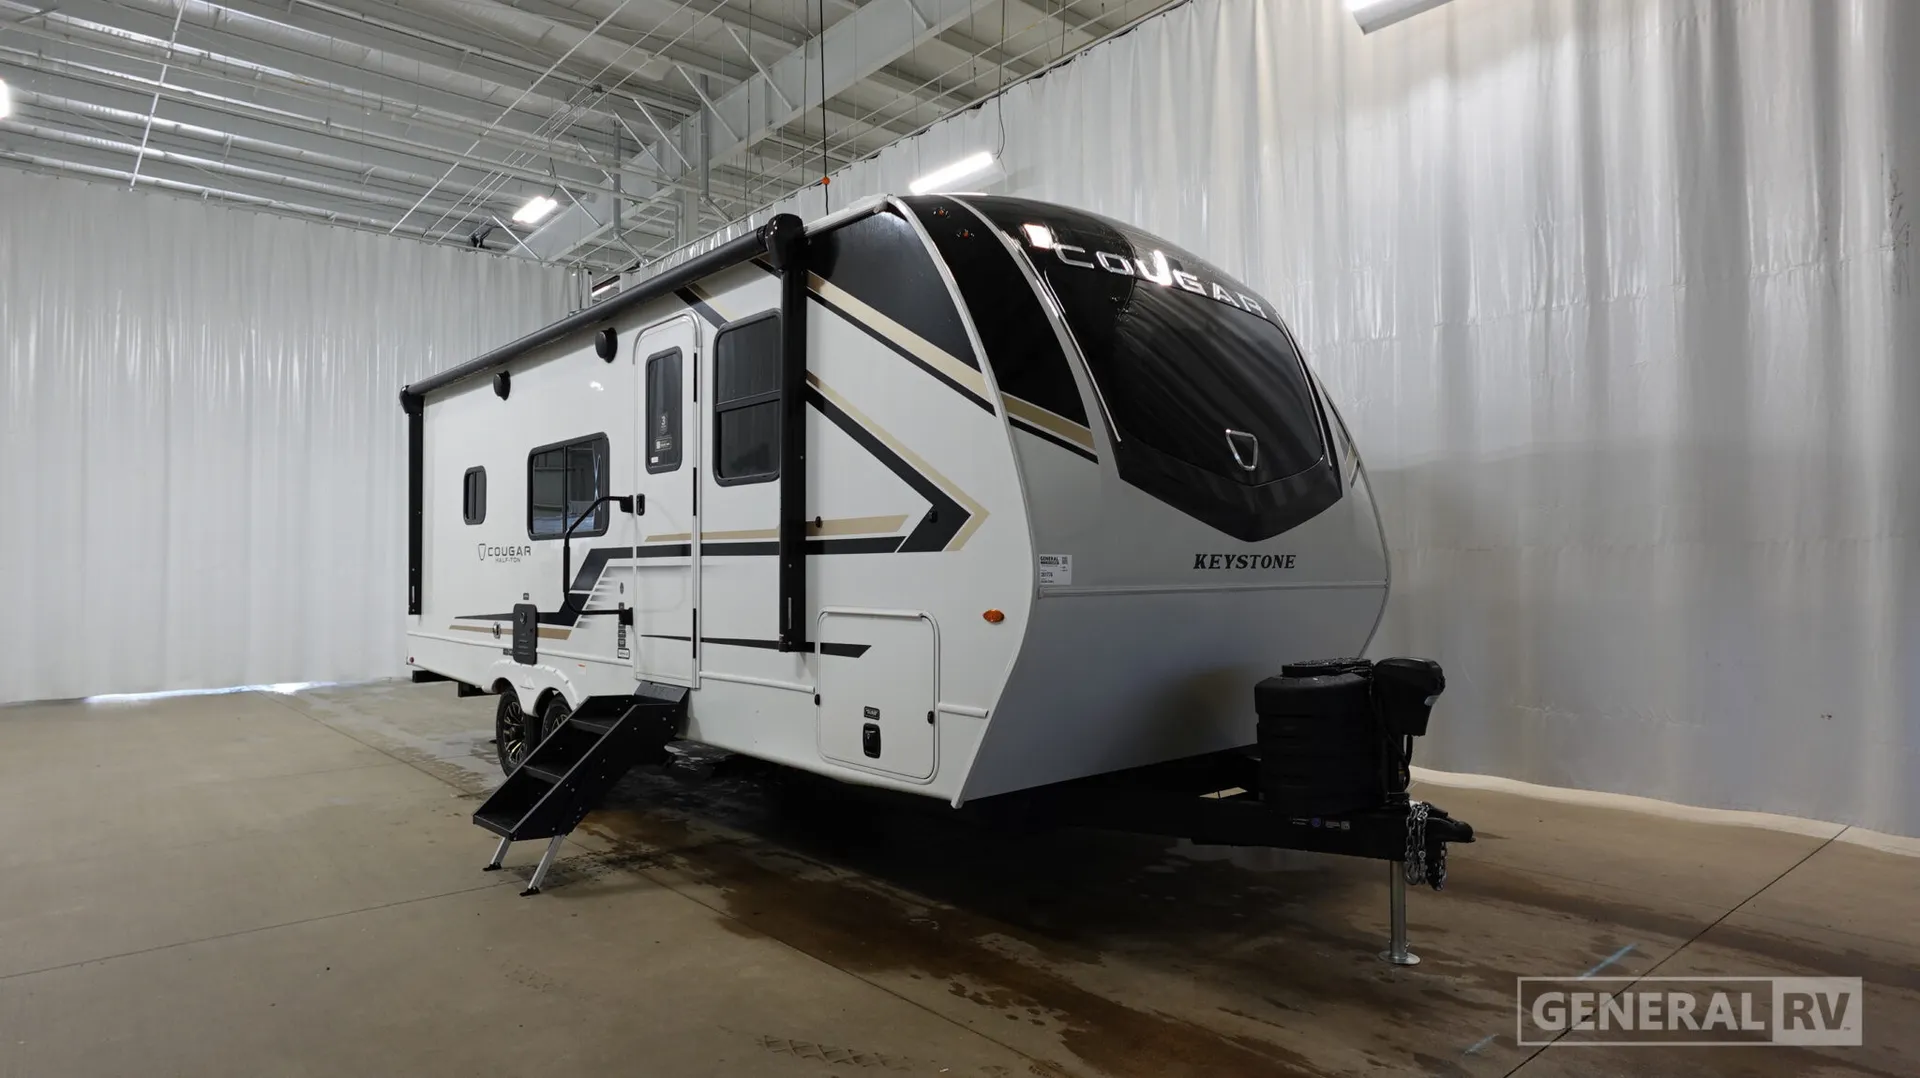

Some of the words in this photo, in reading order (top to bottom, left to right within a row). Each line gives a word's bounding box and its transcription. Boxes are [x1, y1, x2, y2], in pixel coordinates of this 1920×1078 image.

[1054, 243, 1267, 318] COUGAR
[487, 546, 531, 557] COUGAR
[1193, 553, 1297, 570] KEYSTONE
